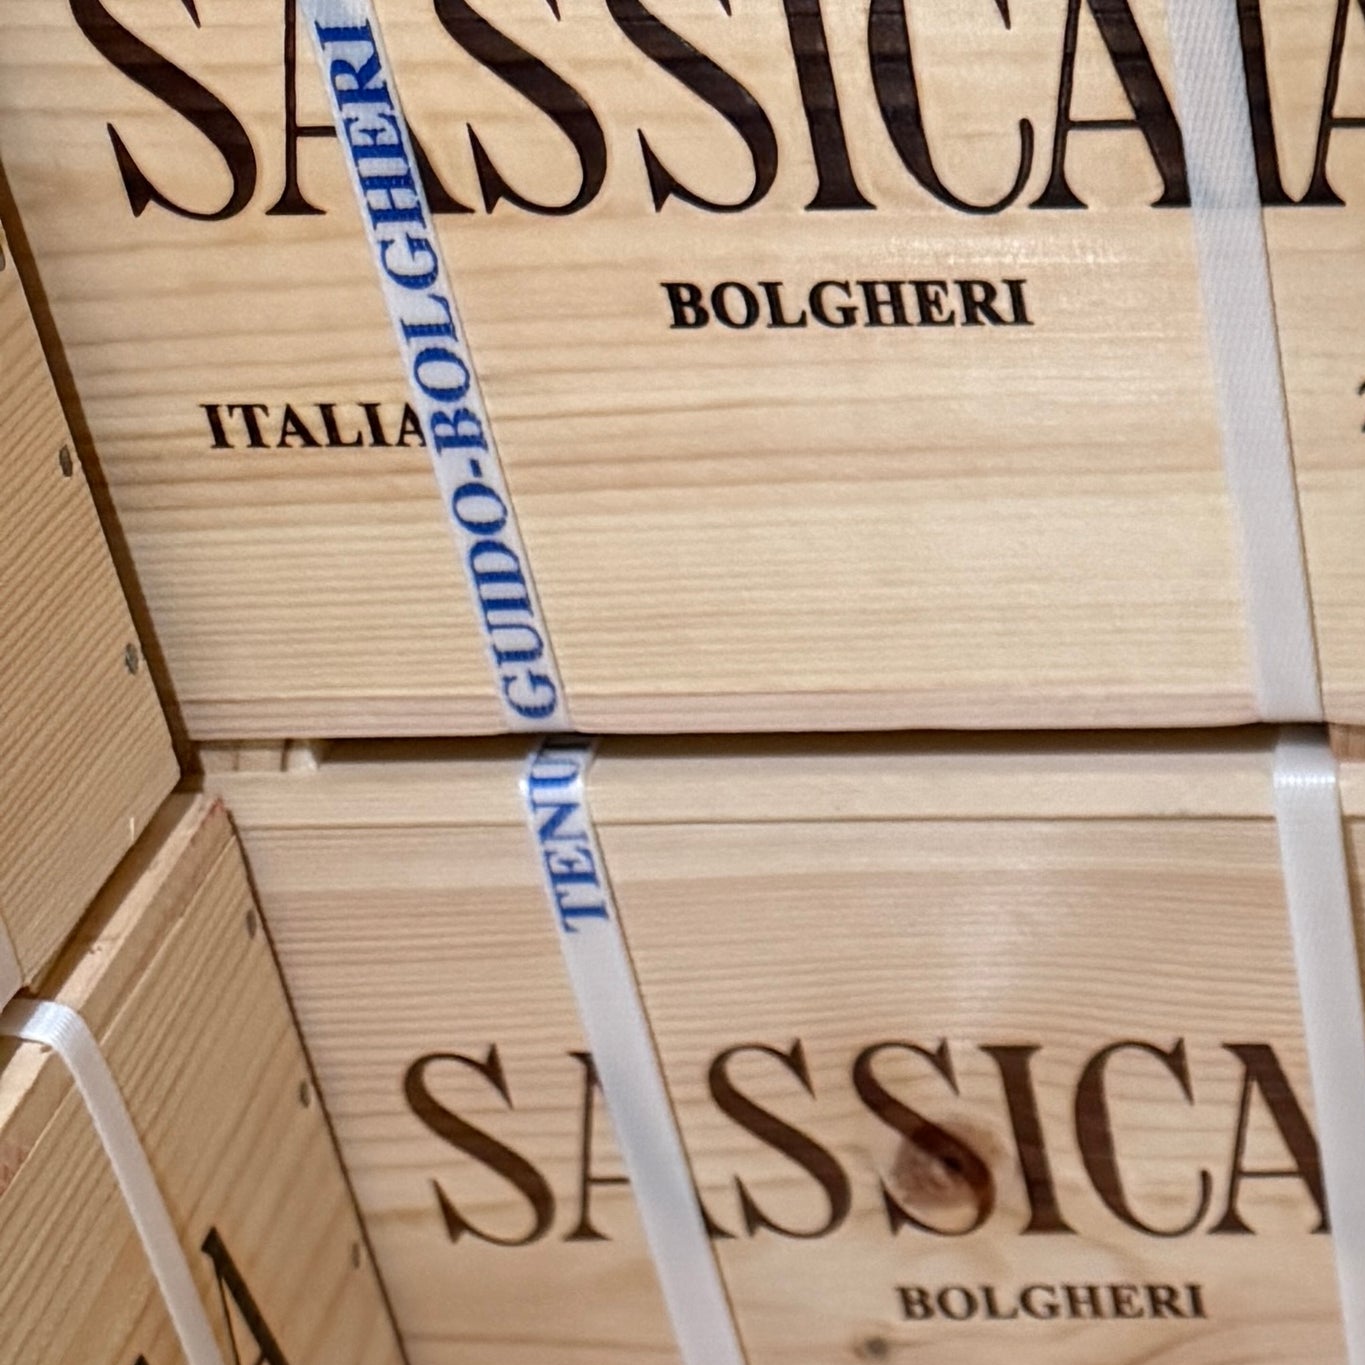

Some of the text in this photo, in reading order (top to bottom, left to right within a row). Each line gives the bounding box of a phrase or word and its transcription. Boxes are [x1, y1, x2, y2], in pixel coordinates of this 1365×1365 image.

[661, 279, 1033, 329] BOLGHERI
[314, 18, 557, 719] GUIDO-BOLGHERI
[199, 402, 427, 449] ITALIA
[895, 1282, 1208, 1320] BOLGHERI
